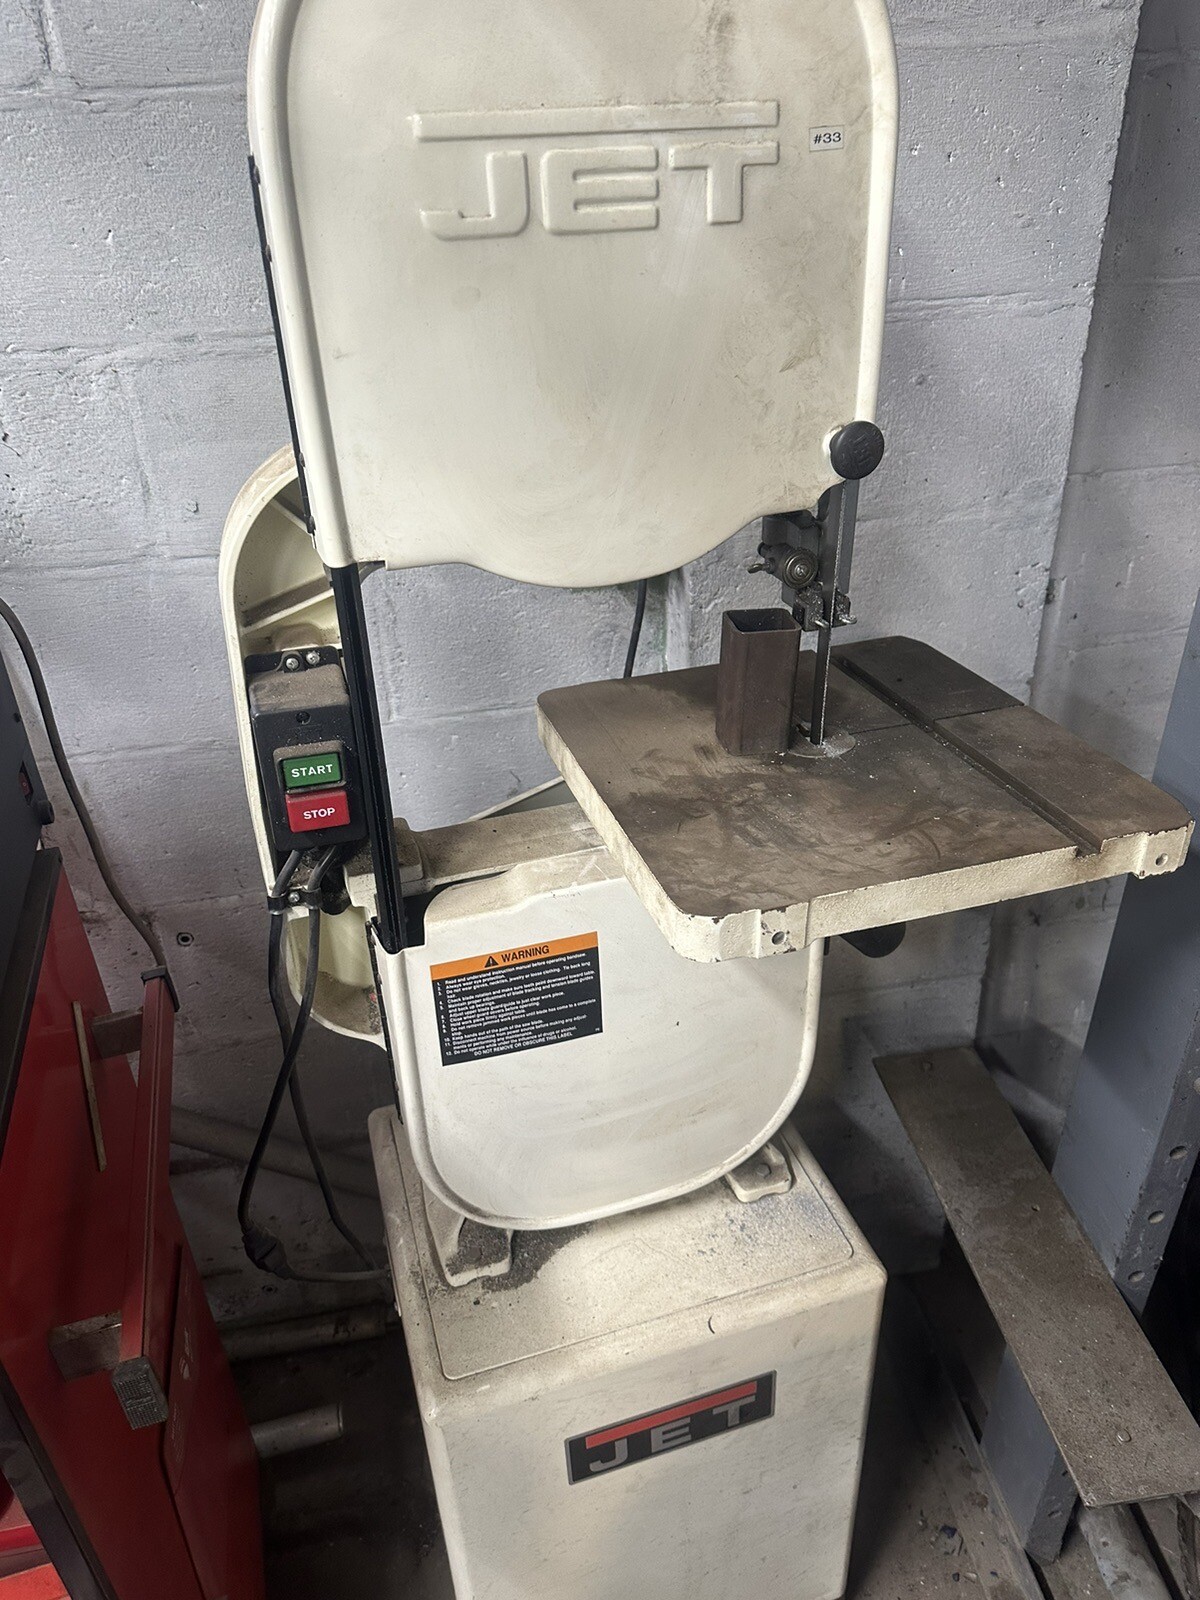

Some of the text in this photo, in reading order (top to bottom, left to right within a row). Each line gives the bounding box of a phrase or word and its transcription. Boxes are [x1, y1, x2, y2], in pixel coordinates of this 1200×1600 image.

[813, 131, 842, 146] #33
[419, 139, 779, 241] JET
[291, 763, 333, 778] START
[303, 807, 335, 819] STOP
[501, 945, 550, 963] WARNING
[589, 1395, 756, 1472] JET
